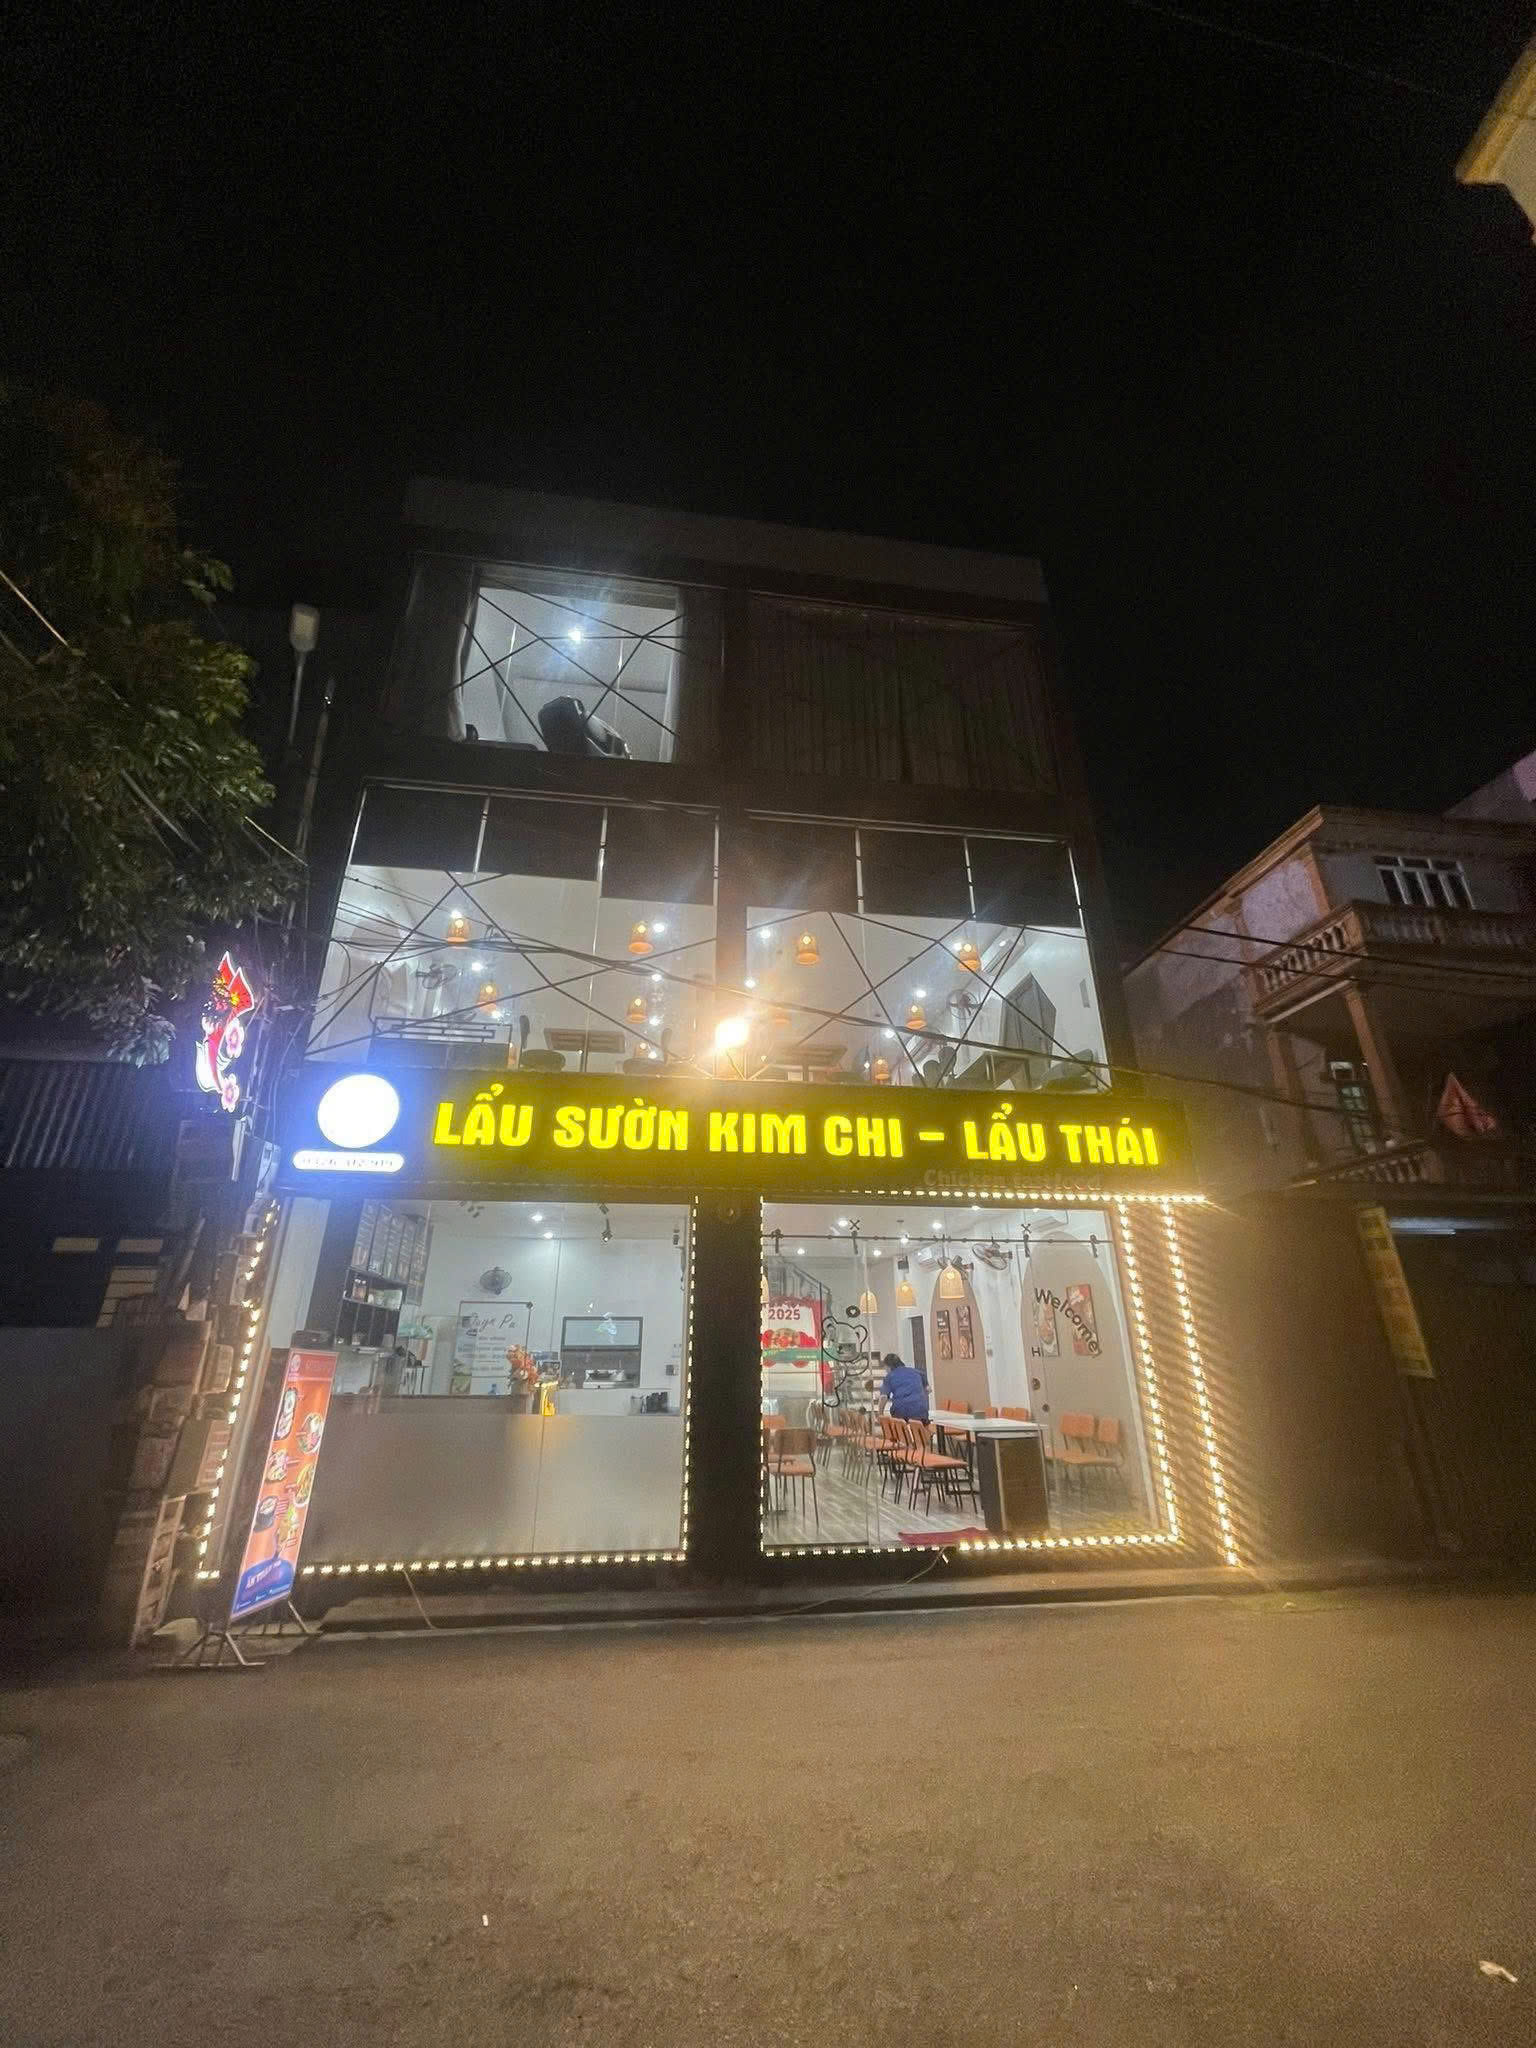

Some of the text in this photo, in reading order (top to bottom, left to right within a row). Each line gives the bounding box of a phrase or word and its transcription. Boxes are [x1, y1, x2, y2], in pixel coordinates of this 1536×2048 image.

[434, 1083, 534, 1147] LẨU
[553, 1097, 688, 1150] SƯỜN
[709, 1112, 807, 1154] KIM
[823, 1116, 903, 1158] CHI
[963, 1102, 1047, 1163] LẨU
[1058, 1117, 1159, 1166] THÁI
[769, 1308, 801, 1320] 2025
